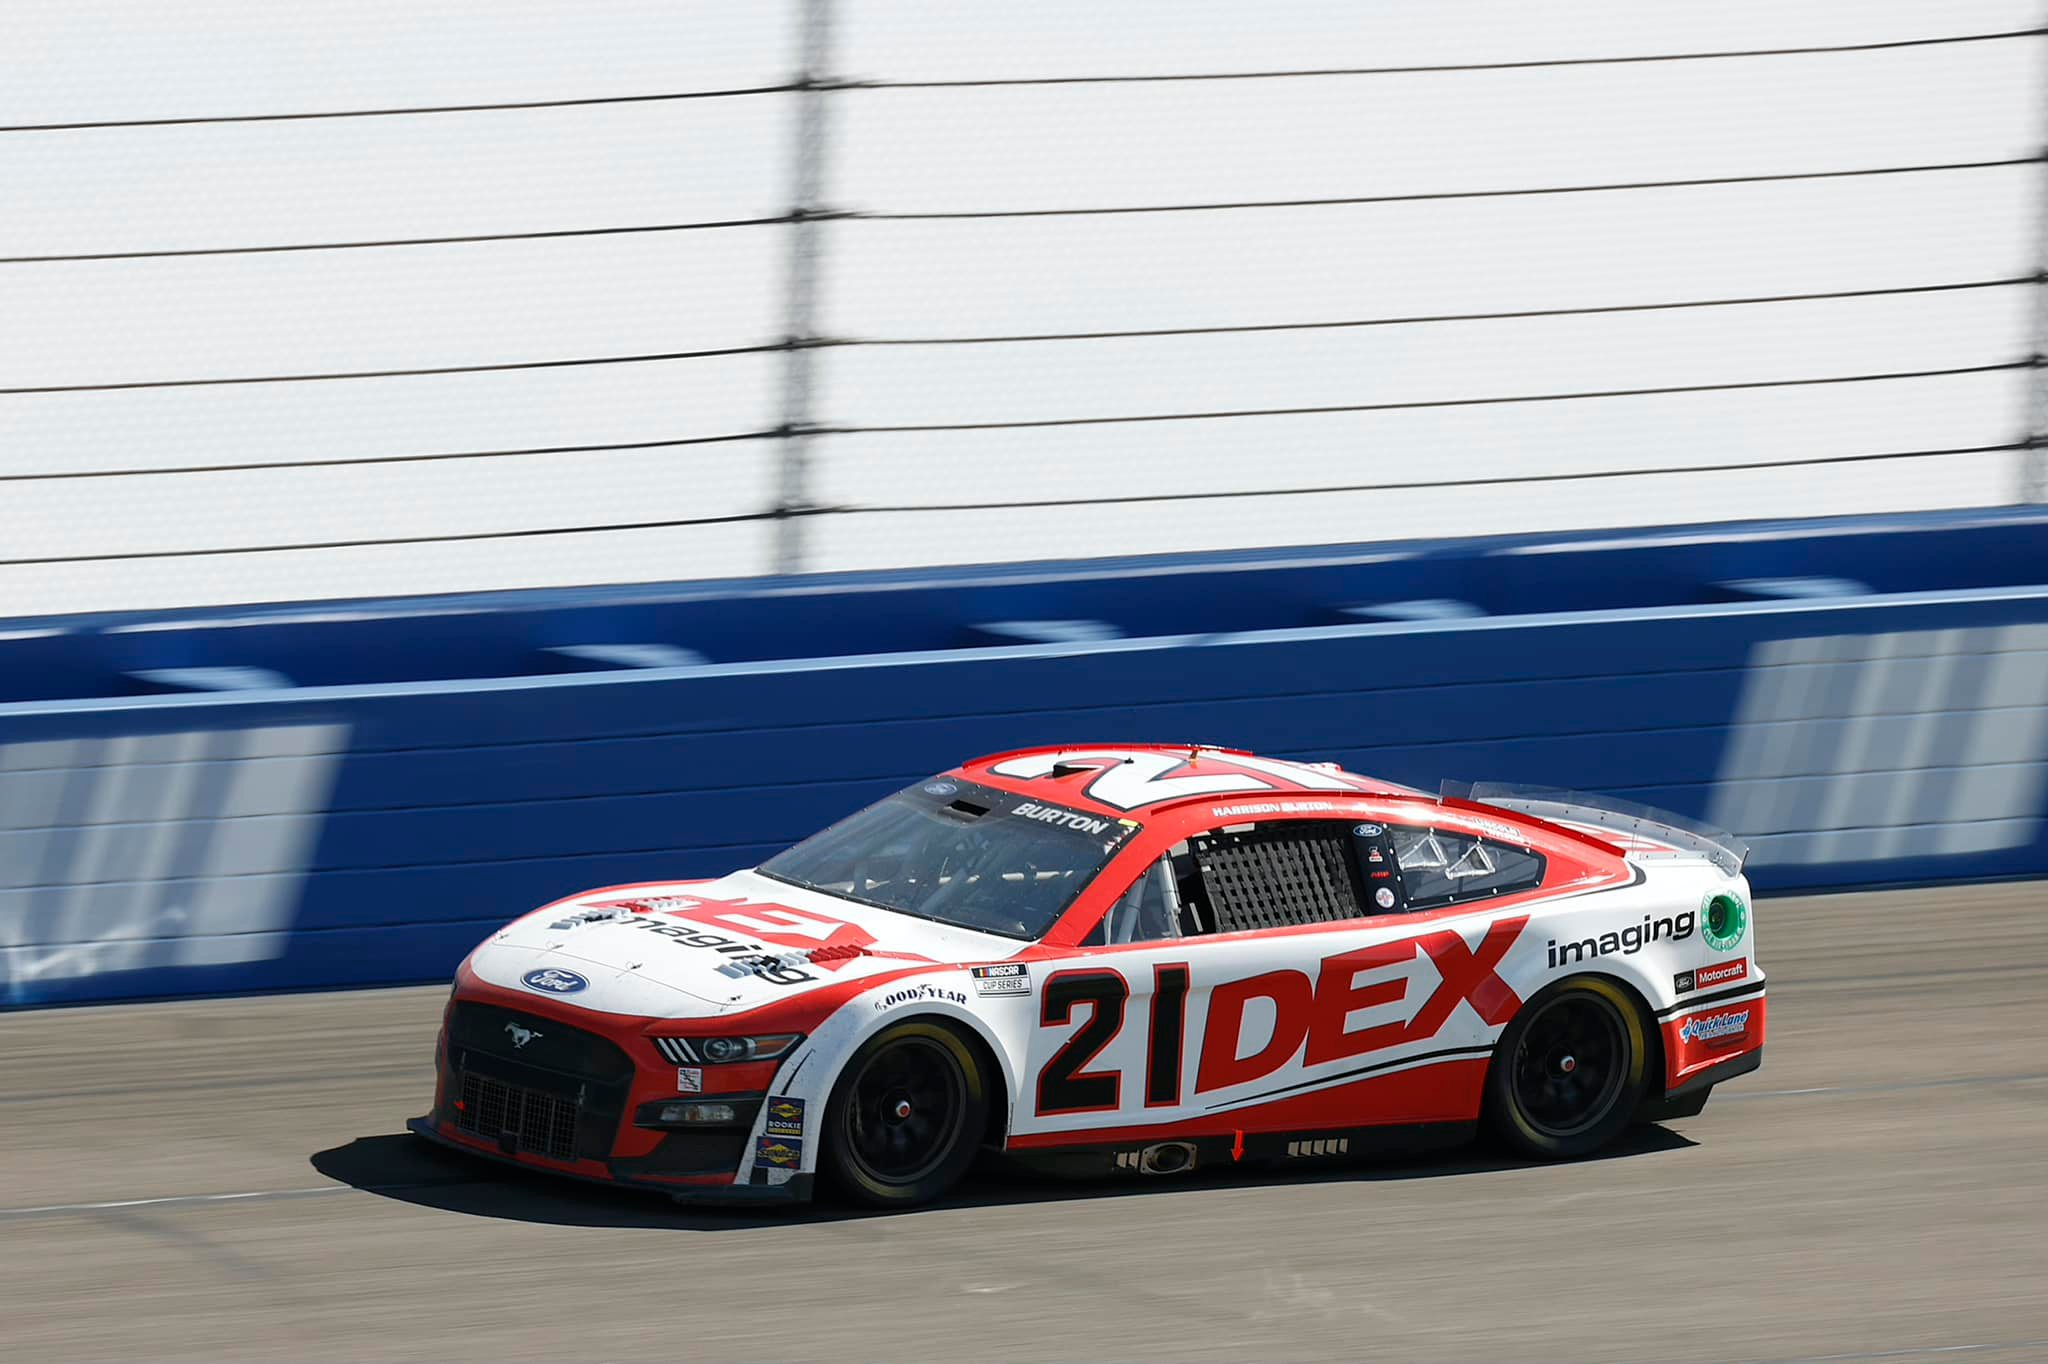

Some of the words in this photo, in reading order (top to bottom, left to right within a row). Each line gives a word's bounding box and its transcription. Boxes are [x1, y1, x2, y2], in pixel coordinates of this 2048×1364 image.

[1011, 802, 1107, 835] BURTON
[1212, 803, 1280, 816] HARRISON
[1548, 910, 1695, 968] imaging
[528, 969, 580, 992] Ford
[990, 965, 1020, 977] NASCAR
[1699, 963, 1743, 984] Motorcraft
[983, 980, 997, 990] CUP
[998, 979, 1022, 989] SERIES
[1692, 1016, 1722, 1035] Quick
[1034, 961, 1191, 1117] 21
[768, 1120, 801, 1129] ROOKIE
